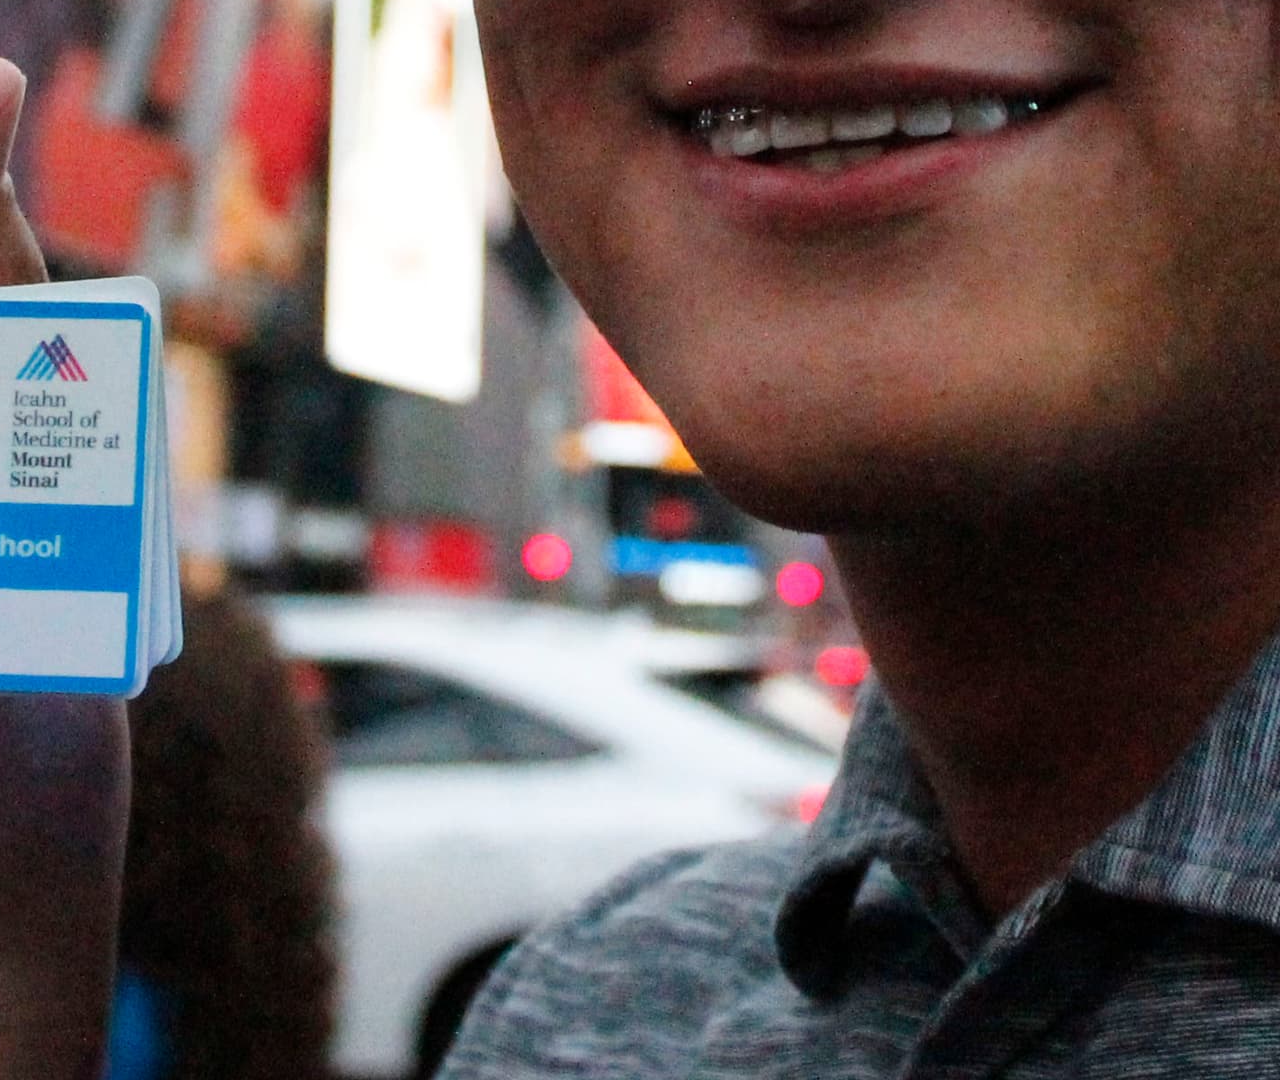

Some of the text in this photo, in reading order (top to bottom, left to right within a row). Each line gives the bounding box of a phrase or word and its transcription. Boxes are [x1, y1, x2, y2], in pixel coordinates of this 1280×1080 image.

[14, 390, 67, 407] Icahn
[12, 410, 101, 428] School of
[11, 431, 120, 449] Medicine at
[11, 451, 72, 469] Mount
[10, 472, 59, 488] Sinai
